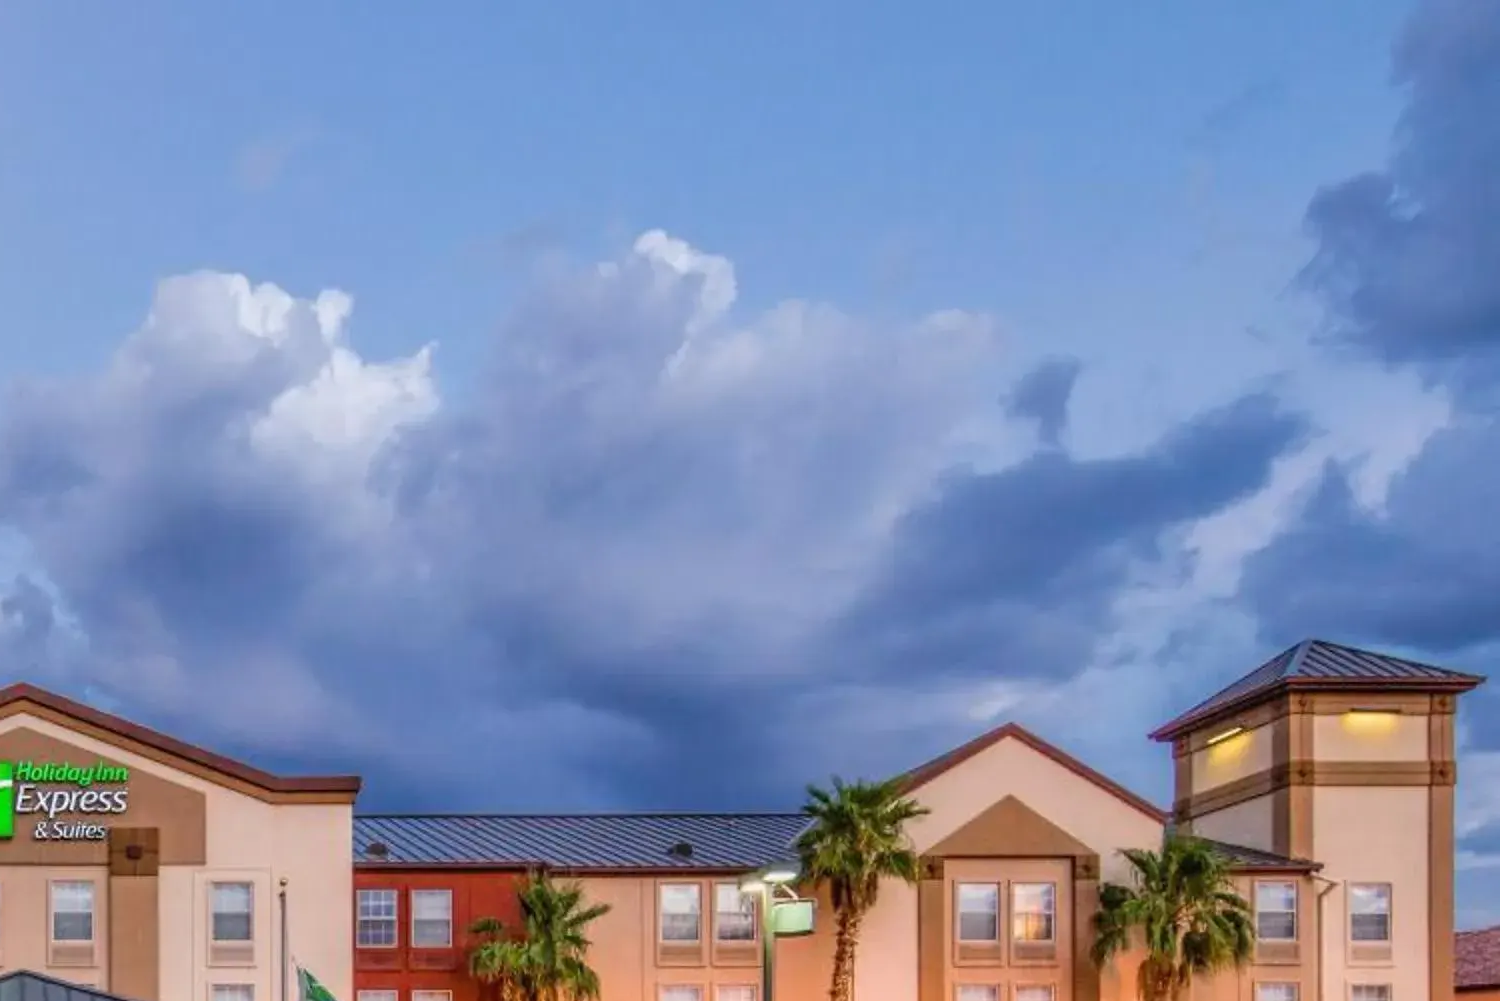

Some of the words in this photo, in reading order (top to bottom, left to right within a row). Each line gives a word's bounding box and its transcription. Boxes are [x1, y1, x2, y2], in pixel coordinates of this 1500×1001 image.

[16, 761, 95, 786] Holiday
[96, 761, 128, 782] Inn
[15, 783, 128, 818] Express
[35, 822, 48, 839] &
[51, 820, 106, 840] Suites
